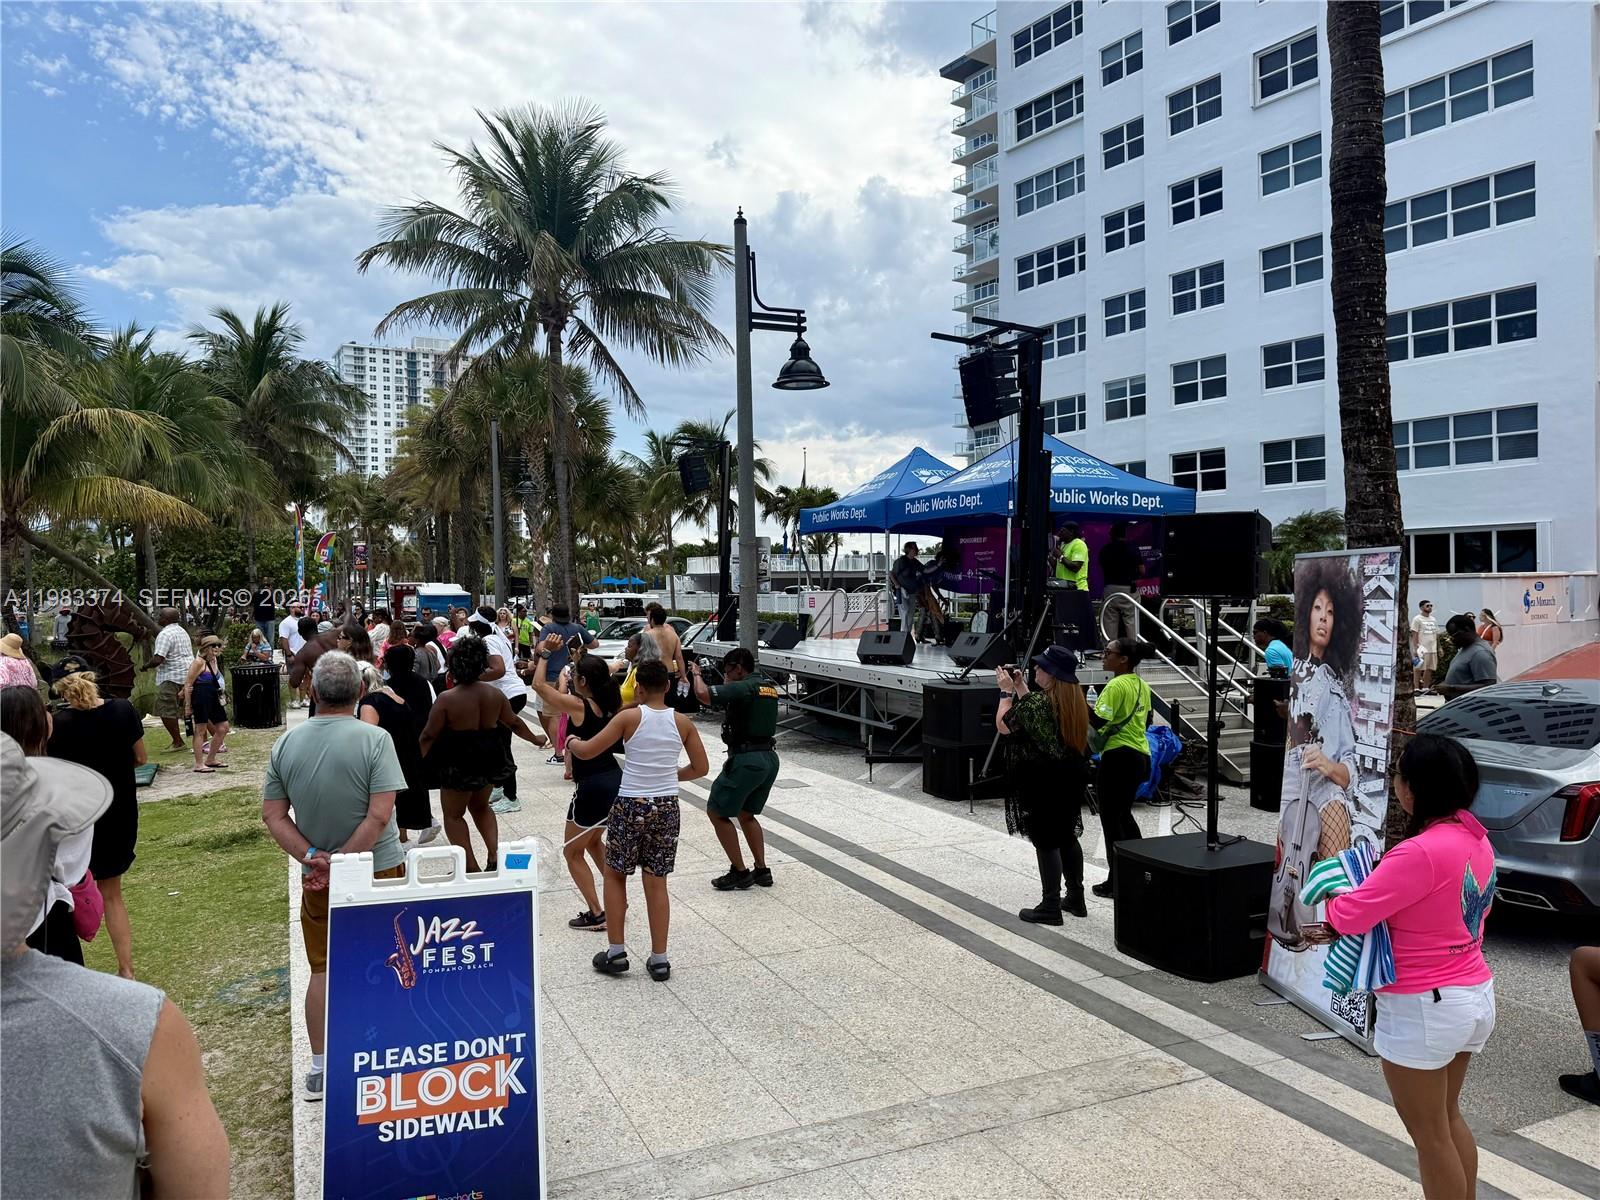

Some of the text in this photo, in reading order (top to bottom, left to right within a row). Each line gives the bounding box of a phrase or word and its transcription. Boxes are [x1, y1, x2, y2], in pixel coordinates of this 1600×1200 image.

[905, 492, 983, 515] Public Works Dept.
[1049, 488, 1164, 511] Public Works Dept.
[812, 507, 868, 524] Public Works Dept.
[1536, 595, 1556, 607] Monarch
[409, 915, 485, 956] JAZZ
[422, 942, 495, 968] FEST
[422, 963, 494, 975] POMPANO BEACH
[353, 1033, 527, 1073] PLEASE DON'T
[356, 1057, 528, 1116] BLOCK
[378, 1106, 505, 1142] SIDEWALK
